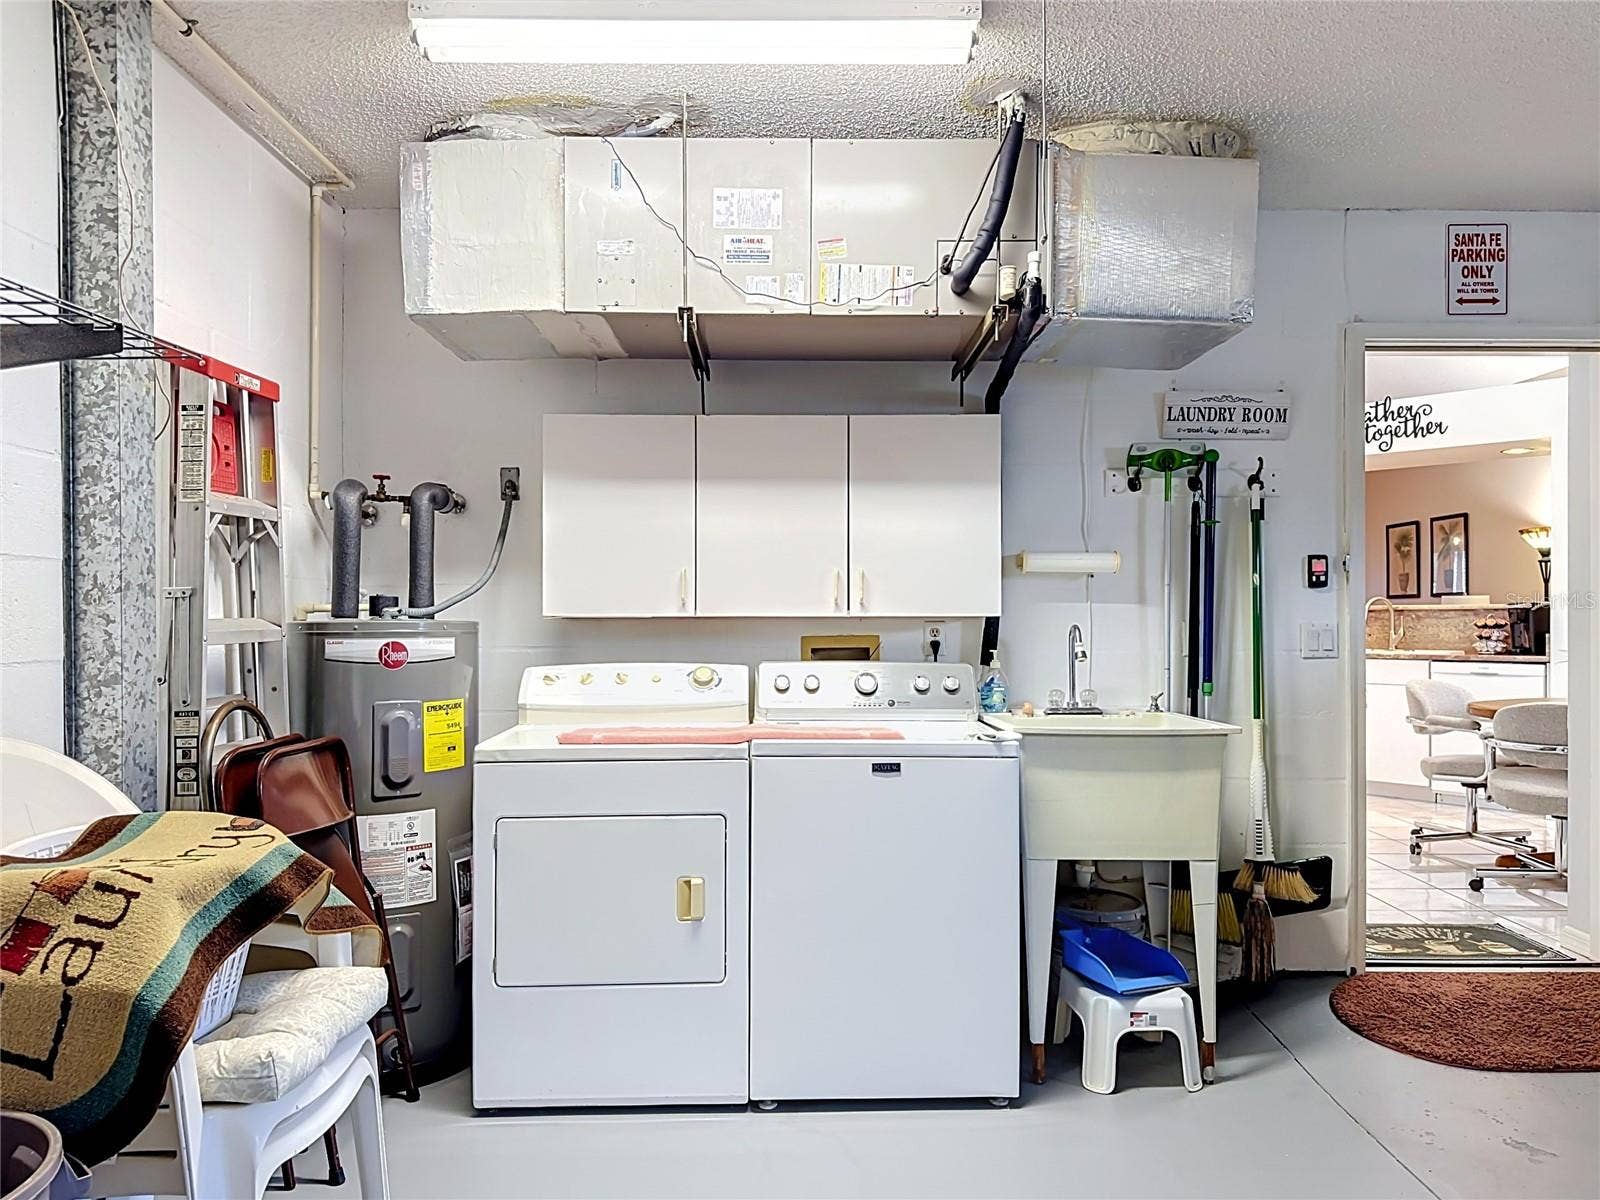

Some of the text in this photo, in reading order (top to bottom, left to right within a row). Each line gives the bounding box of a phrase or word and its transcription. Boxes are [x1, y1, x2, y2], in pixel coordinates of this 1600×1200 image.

[1454, 233, 1502, 247] SANTA FE
[1451, 248, 1505, 263] PARKING
[1461, 265, 1494, 279] ONLY
[1166, 406, 1289, 423] LAUNDRY ROOM
[1365, 411, 1449, 452] together
[381, 641, 408, 665] Rheem
